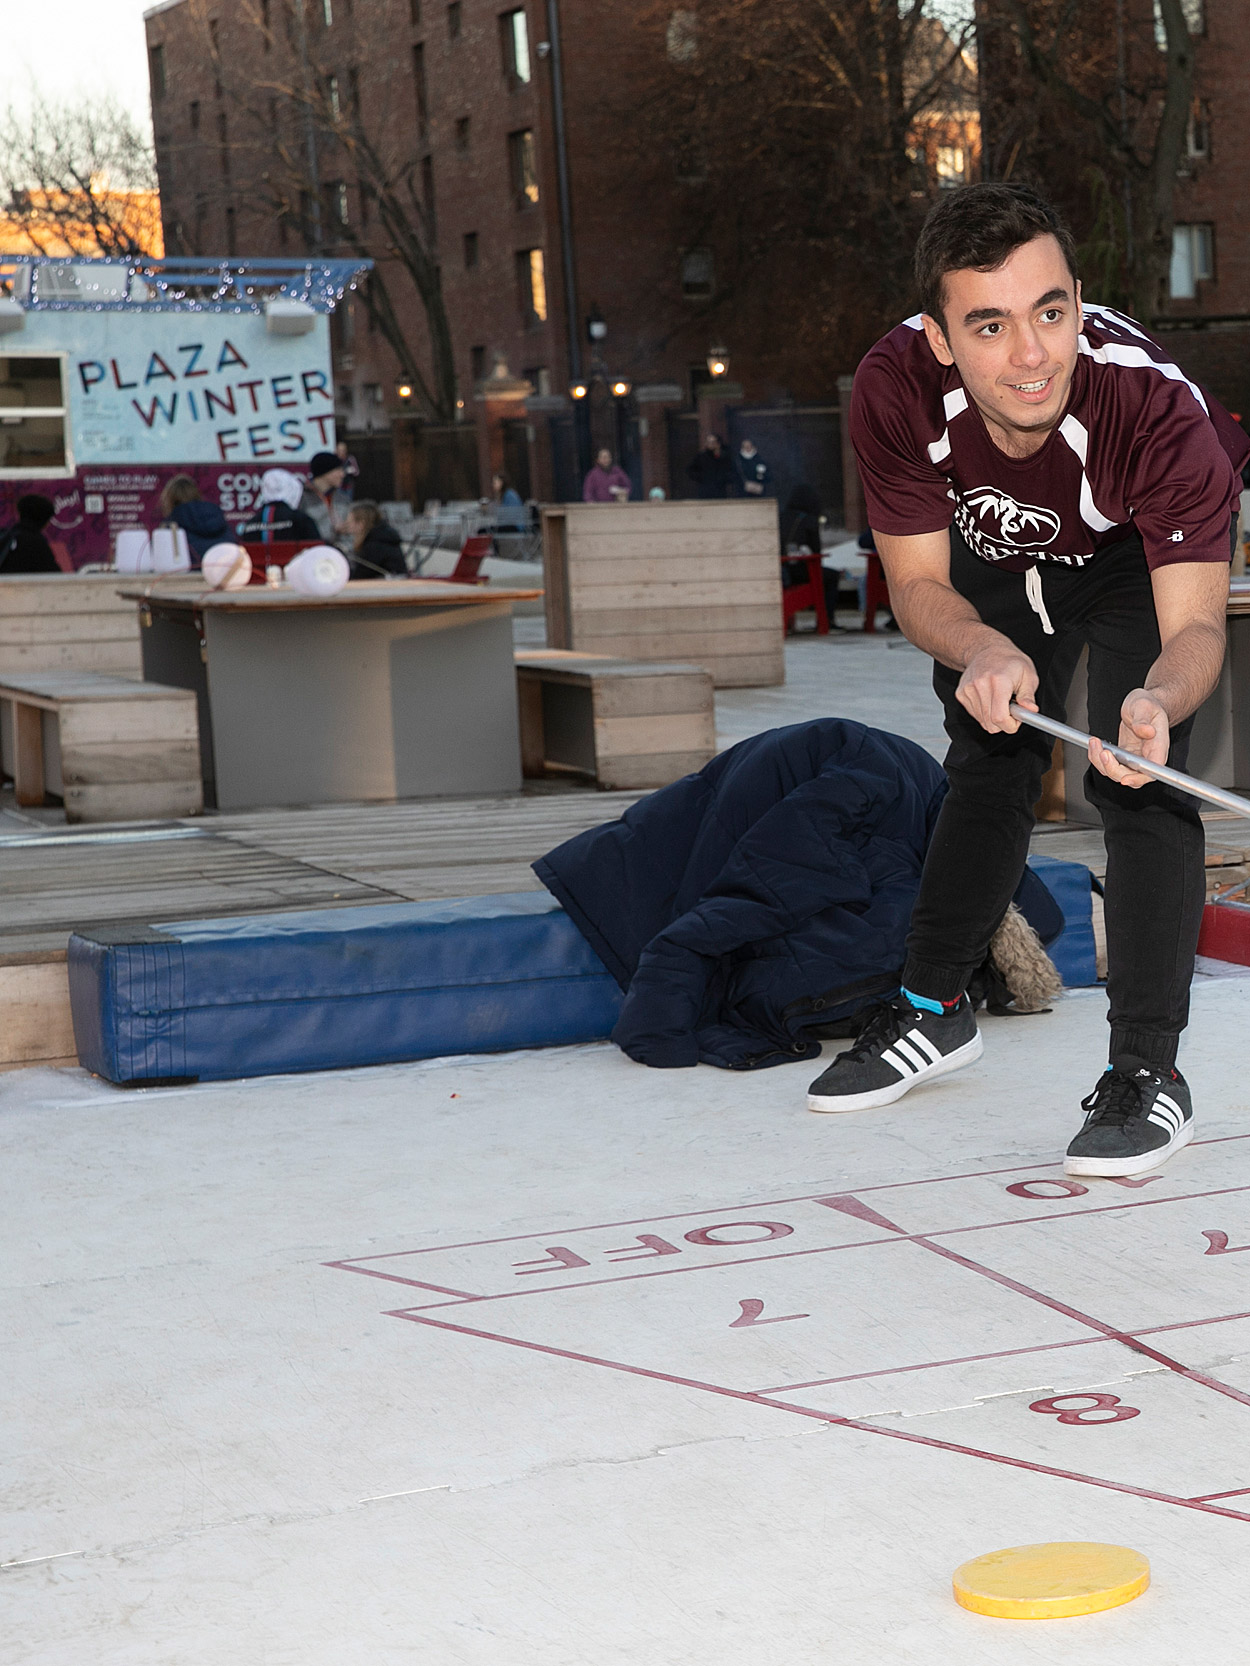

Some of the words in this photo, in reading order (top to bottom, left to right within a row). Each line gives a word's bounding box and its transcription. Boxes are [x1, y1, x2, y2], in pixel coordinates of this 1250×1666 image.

[78, 339, 248, 394] PLAZA
[131, 370, 332, 429] WINTER
[216, 414, 334, 461] FEST
[511, 1221, 794, 1275] OFF
[729, 1299, 810, 1328] 7
[1028, 1393, 1141, 1425] 8
